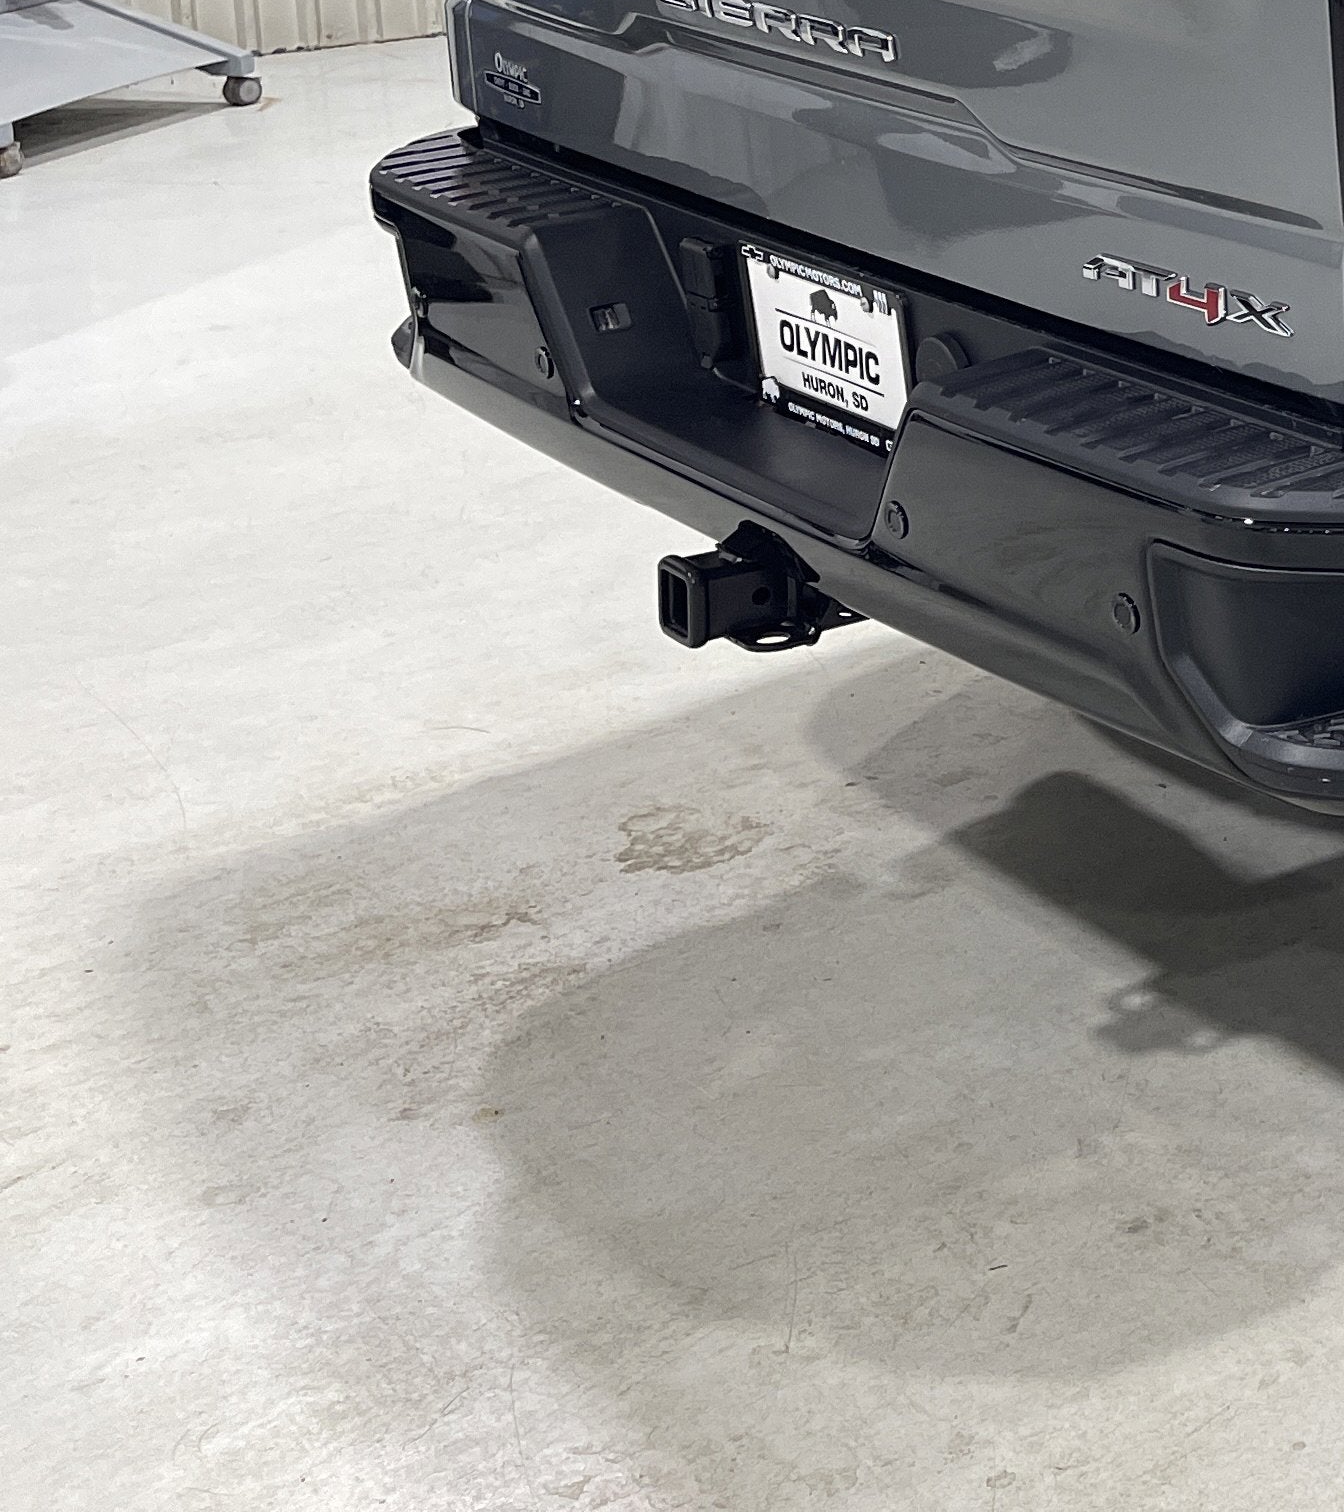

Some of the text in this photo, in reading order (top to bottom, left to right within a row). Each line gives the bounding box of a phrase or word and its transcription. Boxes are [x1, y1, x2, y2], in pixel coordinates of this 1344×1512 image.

[1081, 251, 1295, 338] AT4X
[779, 319, 881, 386] OLYMPIC
[802, 371, 869, 412] HURON, SD
